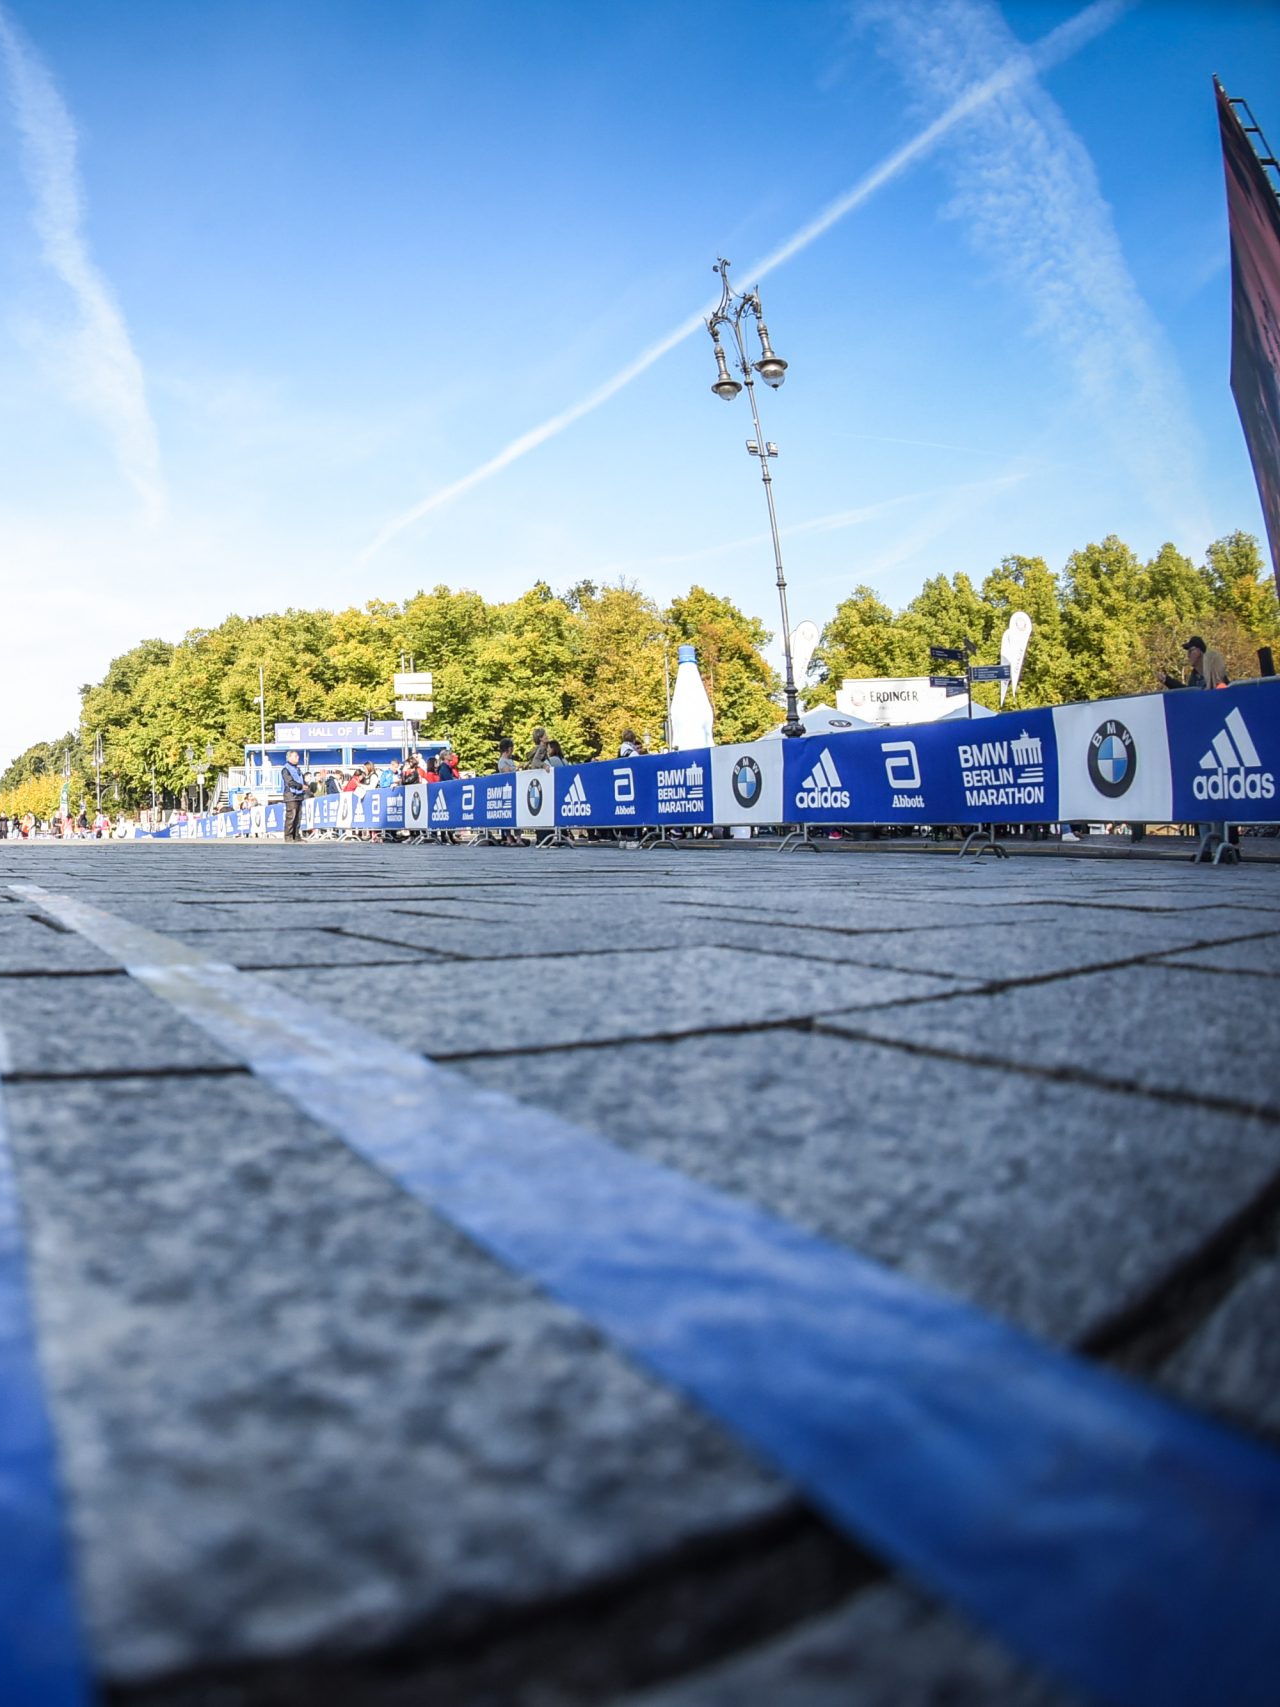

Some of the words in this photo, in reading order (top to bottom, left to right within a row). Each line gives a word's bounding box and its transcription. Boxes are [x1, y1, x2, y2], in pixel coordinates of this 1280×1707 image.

[870, 690, 919, 703] ERDINGER
[308, 727, 333, 737] HALL
[337, 727, 352, 737] OF
[357, 727, 385, 736] FME
[958, 741, 1008, 769] BMW
[657, 769, 685, 787] BMW
[962, 767, 1014, 788] BERLIN
[1193, 766, 1275, 800] adidas
[487, 787, 503, 799] BMW
[658, 787, 686, 800] BERLIN
[795, 788, 850, 809] adidas
[965, 786, 1044, 807] MARATHON
[561, 800, 591, 817] adidas
[658, 800, 704, 814] MARATHON
[892, 794, 925, 808] Abbott
[615, 805, 635, 815] Abbott
